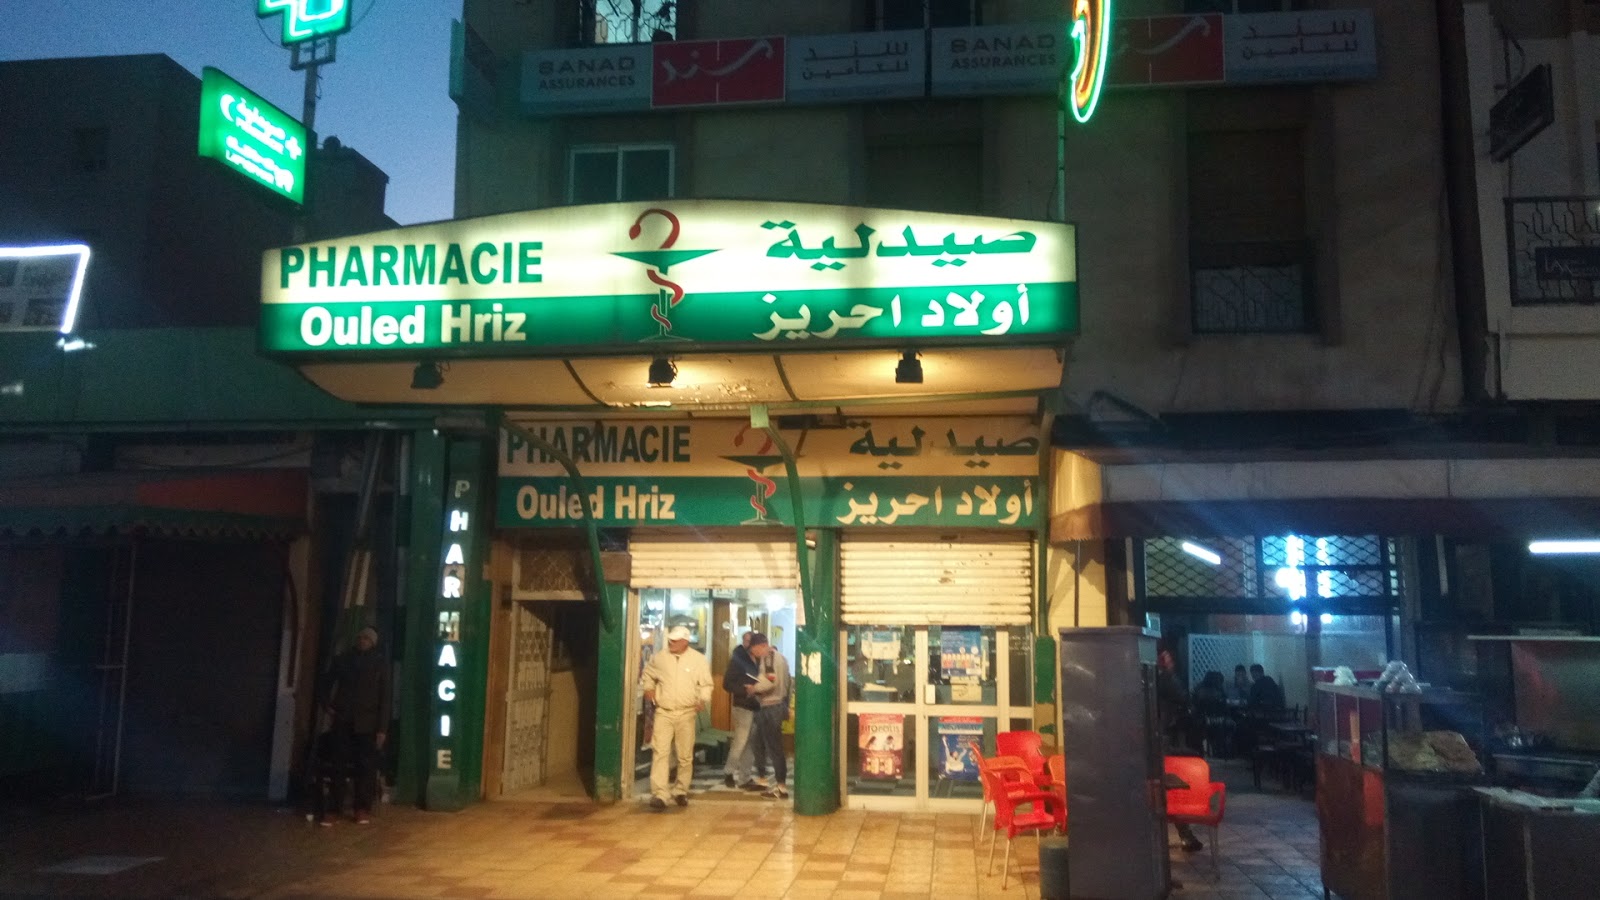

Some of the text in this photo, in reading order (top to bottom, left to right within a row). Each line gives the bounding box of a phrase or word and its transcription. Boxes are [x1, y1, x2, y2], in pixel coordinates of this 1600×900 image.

[538, 56, 635, 75] SANAD
[950, 34, 1056, 54] SANAD
[951, 53, 1057, 70] ASSURANCES
[539, 75, 636, 91] ASSURANCES
[280, 241, 543, 289] PHARMACIE
[760, 219, 1037, 271] صيدلية
[300, 302, 527, 347] Ouled Hriz
[752, 283, 1030, 340] أولاد احريز
[507, 424, 691, 464] PHARMACIE
[846, 420, 1040, 470] صيدلية
[516, 485, 676, 520] Ouled Hriz
[836, 480, 1033, 525] أولاد احريز
[437, 480, 470, 770] PHARMACIE
